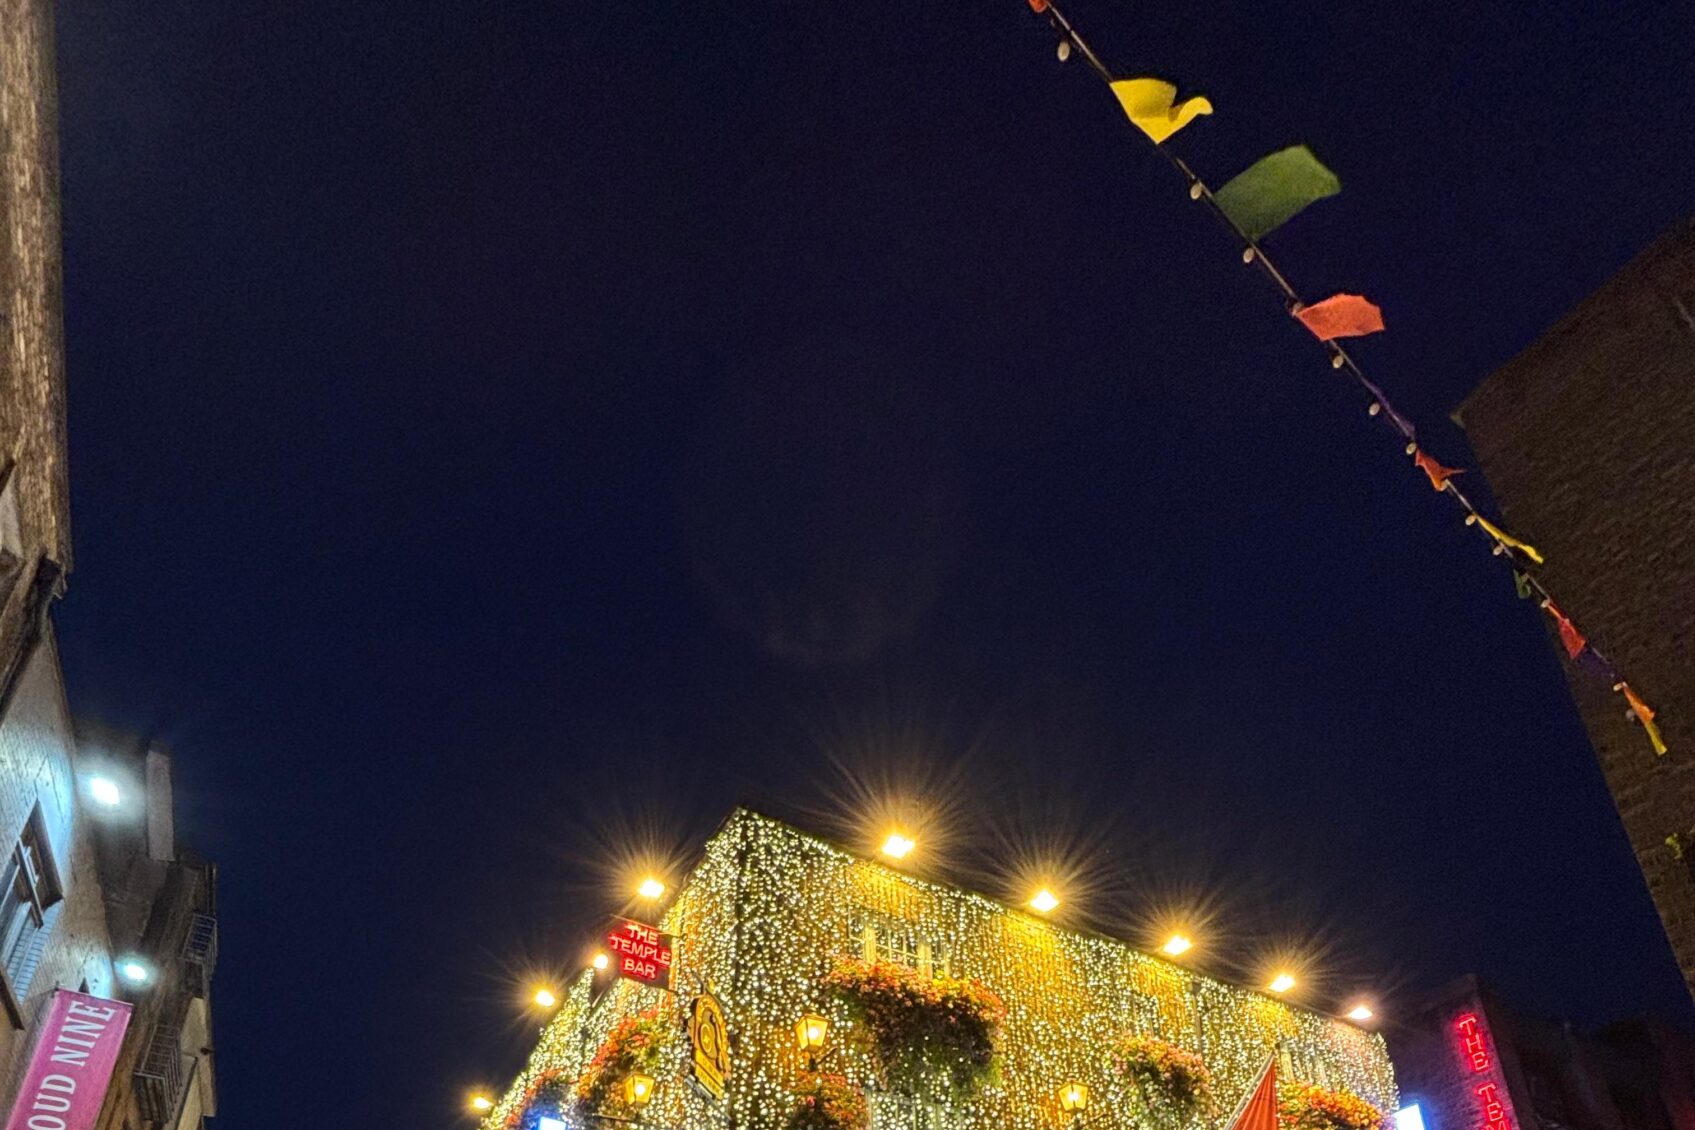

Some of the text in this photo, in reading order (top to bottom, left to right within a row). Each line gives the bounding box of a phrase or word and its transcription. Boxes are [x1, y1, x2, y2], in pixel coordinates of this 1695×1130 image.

[624, 924, 658, 946] THE
[608, 936, 671, 965] TEMPLE
[624, 958, 656, 979] BAR
[50, 1000, 117, 1067] NINE
[1459, 1016, 1489, 1071] THE
